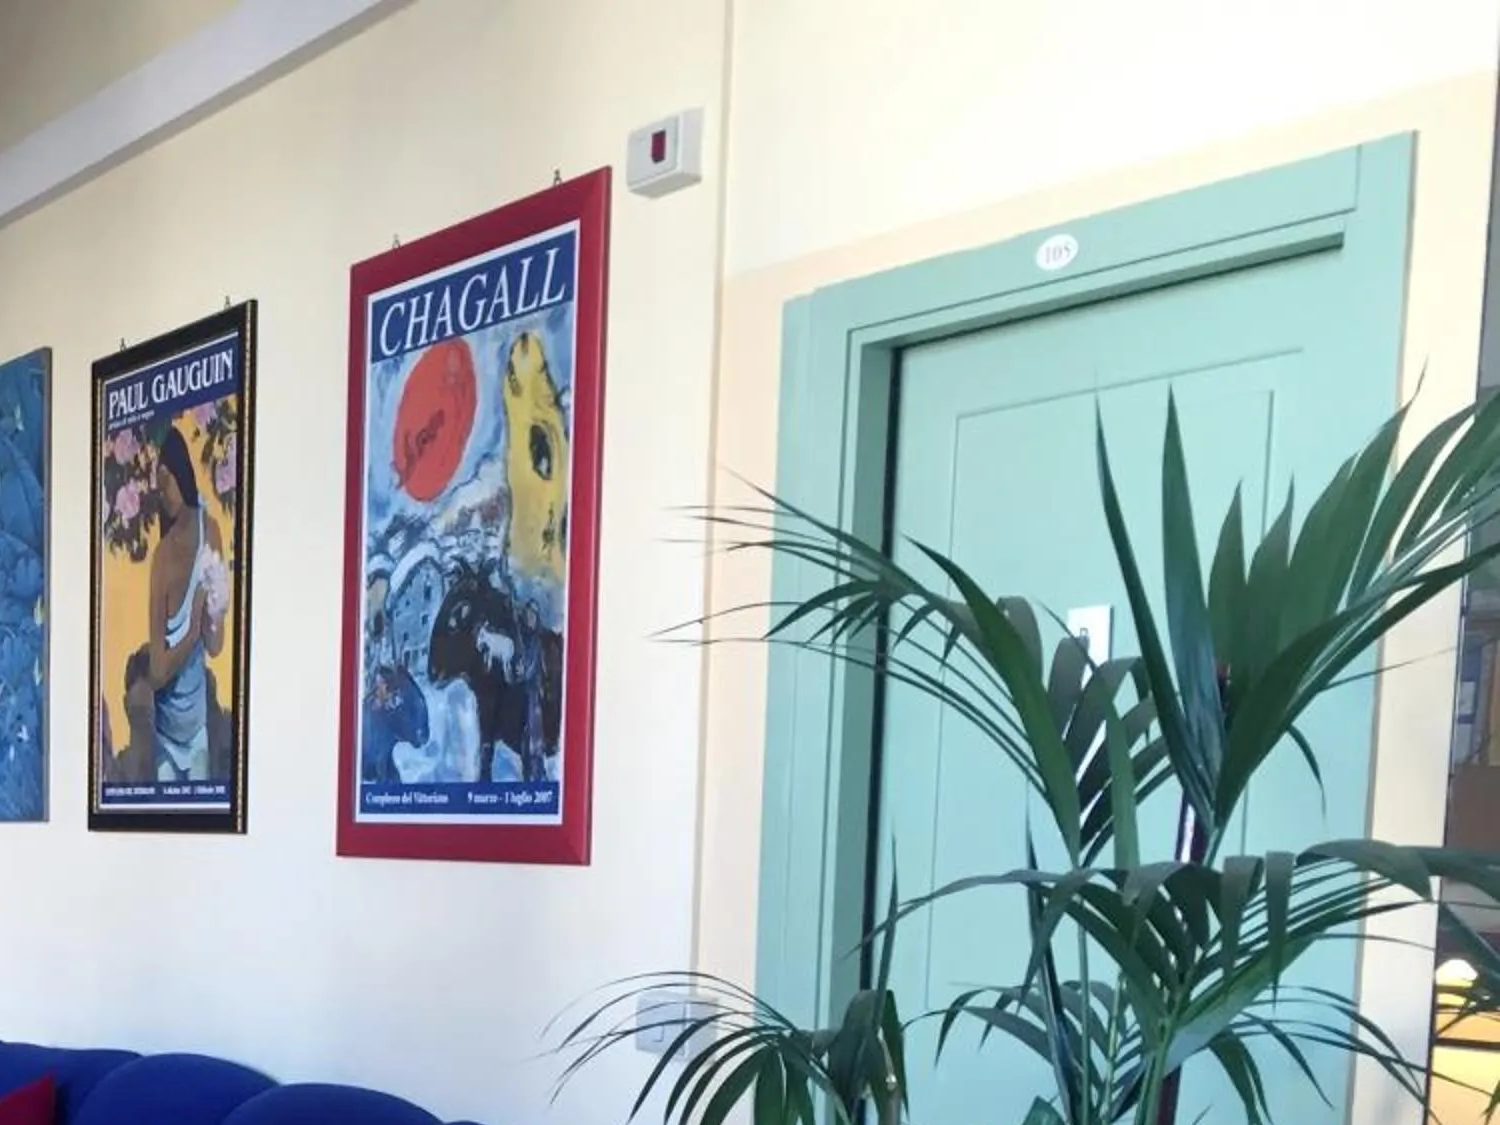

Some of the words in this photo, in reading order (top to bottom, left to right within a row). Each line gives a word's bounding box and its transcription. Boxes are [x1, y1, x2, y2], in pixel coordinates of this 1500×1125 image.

[1045, 243, 1071, 265] 105
[379, 248, 567, 356] CHAGALL
[108, 381, 149, 420] PAUL
[151, 348, 234, 404] GAUGUIN
